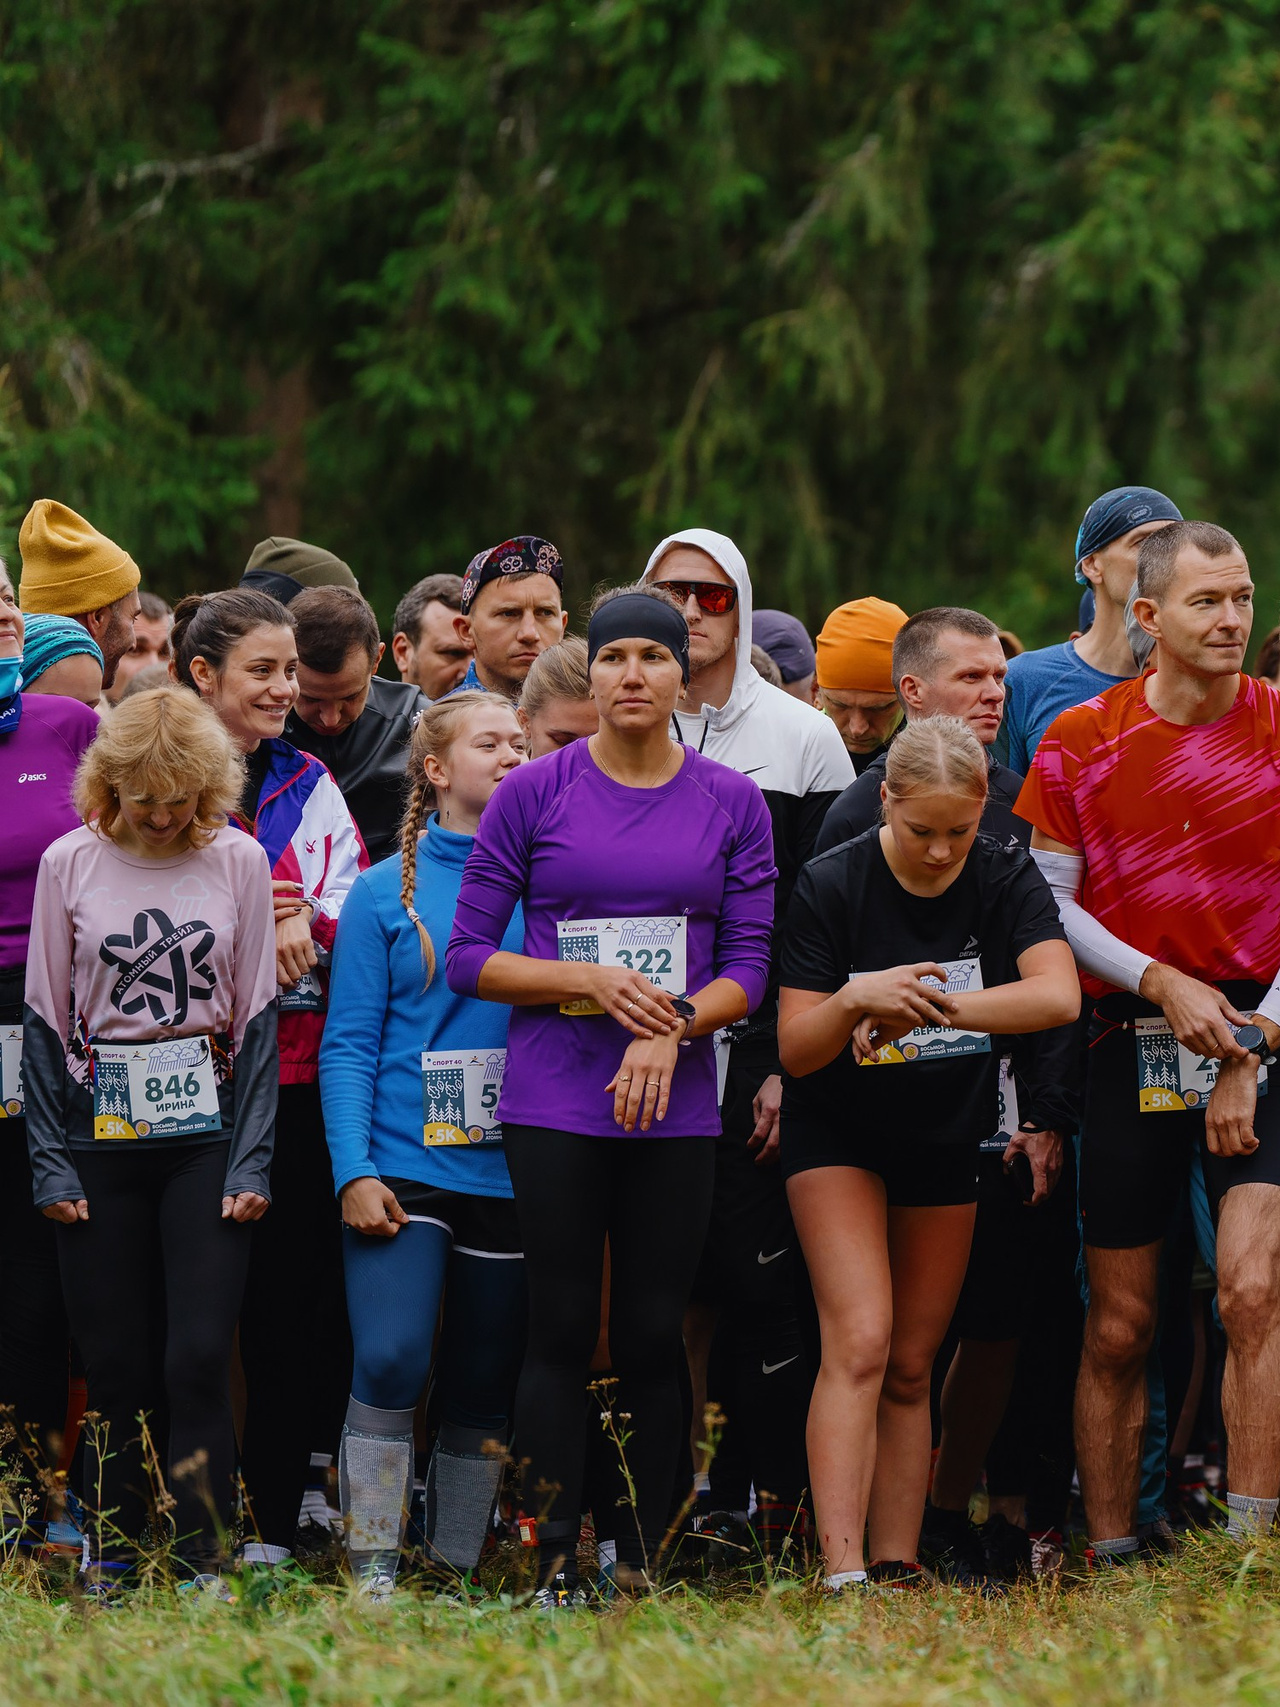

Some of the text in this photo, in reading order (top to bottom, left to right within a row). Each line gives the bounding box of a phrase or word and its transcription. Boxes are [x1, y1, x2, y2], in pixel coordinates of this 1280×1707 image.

[115, 924, 195, 995] АТОМНЫЙ ТРЕЙЛ
[615, 948, 672, 974] 322
[880, 1047, 892, 1061] K
[921, 1049, 946, 1057] АТОМНЫЙ
[947, 1046, 963, 1054] ТРЕЙЛ
[145, 1072, 201, 1103] 846
[481, 1083, 502, 1109] 5
[1152, 1093, 1173, 1107] 5K
[155, 1099, 196, 1113] ИРИНА
[106, 1121, 126, 1135] 5K
[152, 1126, 178, 1134] АТОМНЫЙ
[179, 1124, 194, 1132] ТРЕЙЛ
[436, 1128, 457, 1142] 5K
